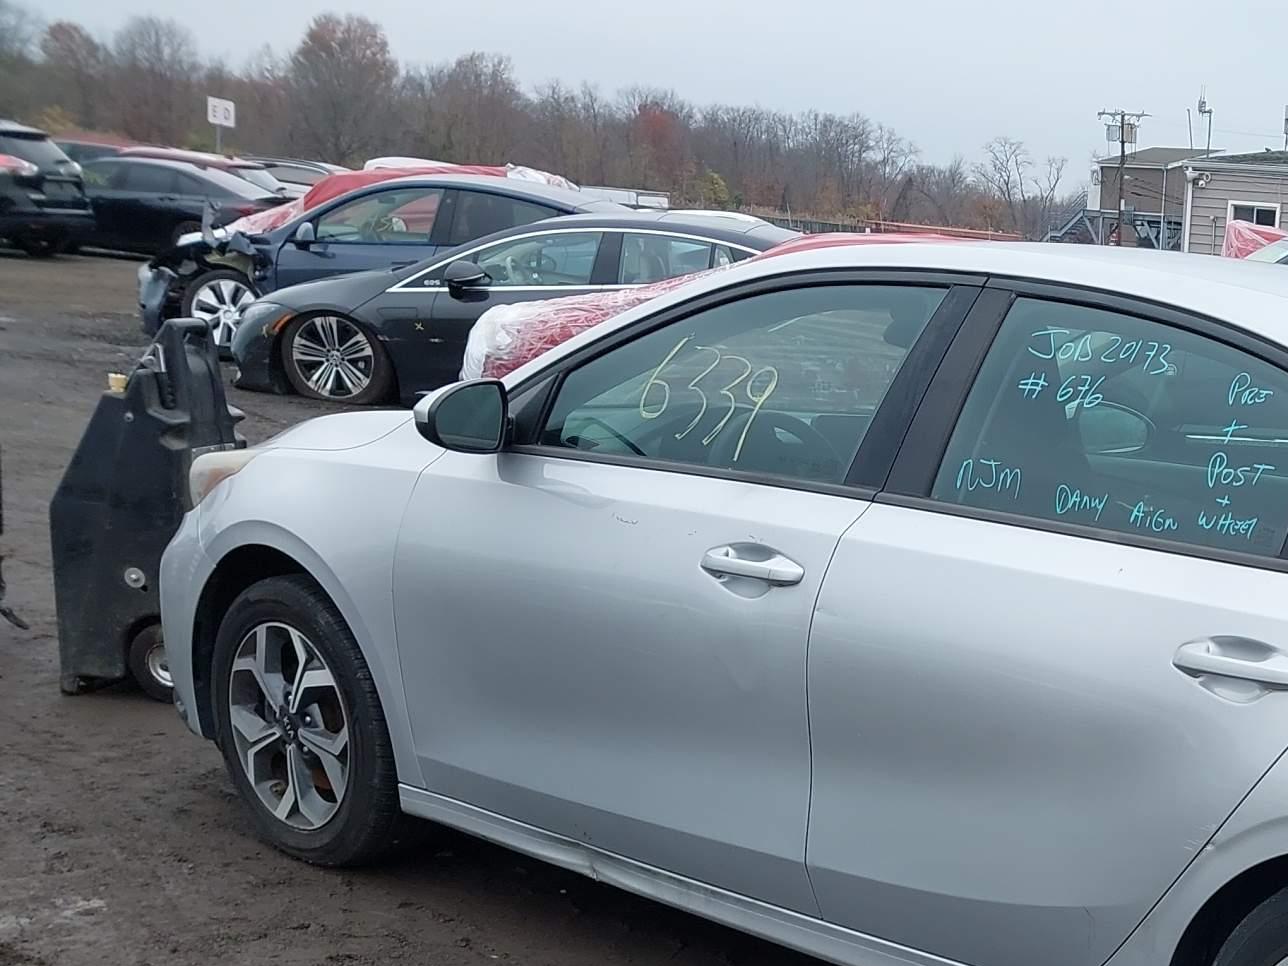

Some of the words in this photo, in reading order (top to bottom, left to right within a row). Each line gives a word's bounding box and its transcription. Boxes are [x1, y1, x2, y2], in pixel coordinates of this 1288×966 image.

[1028, 330, 1092, 361] JOB
[1100, 336, 1171, 375] 20173
[640, 331, 778, 461] 6339
[1056, 375, 1106, 408] 676
[1207, 452, 1275, 488] POST
